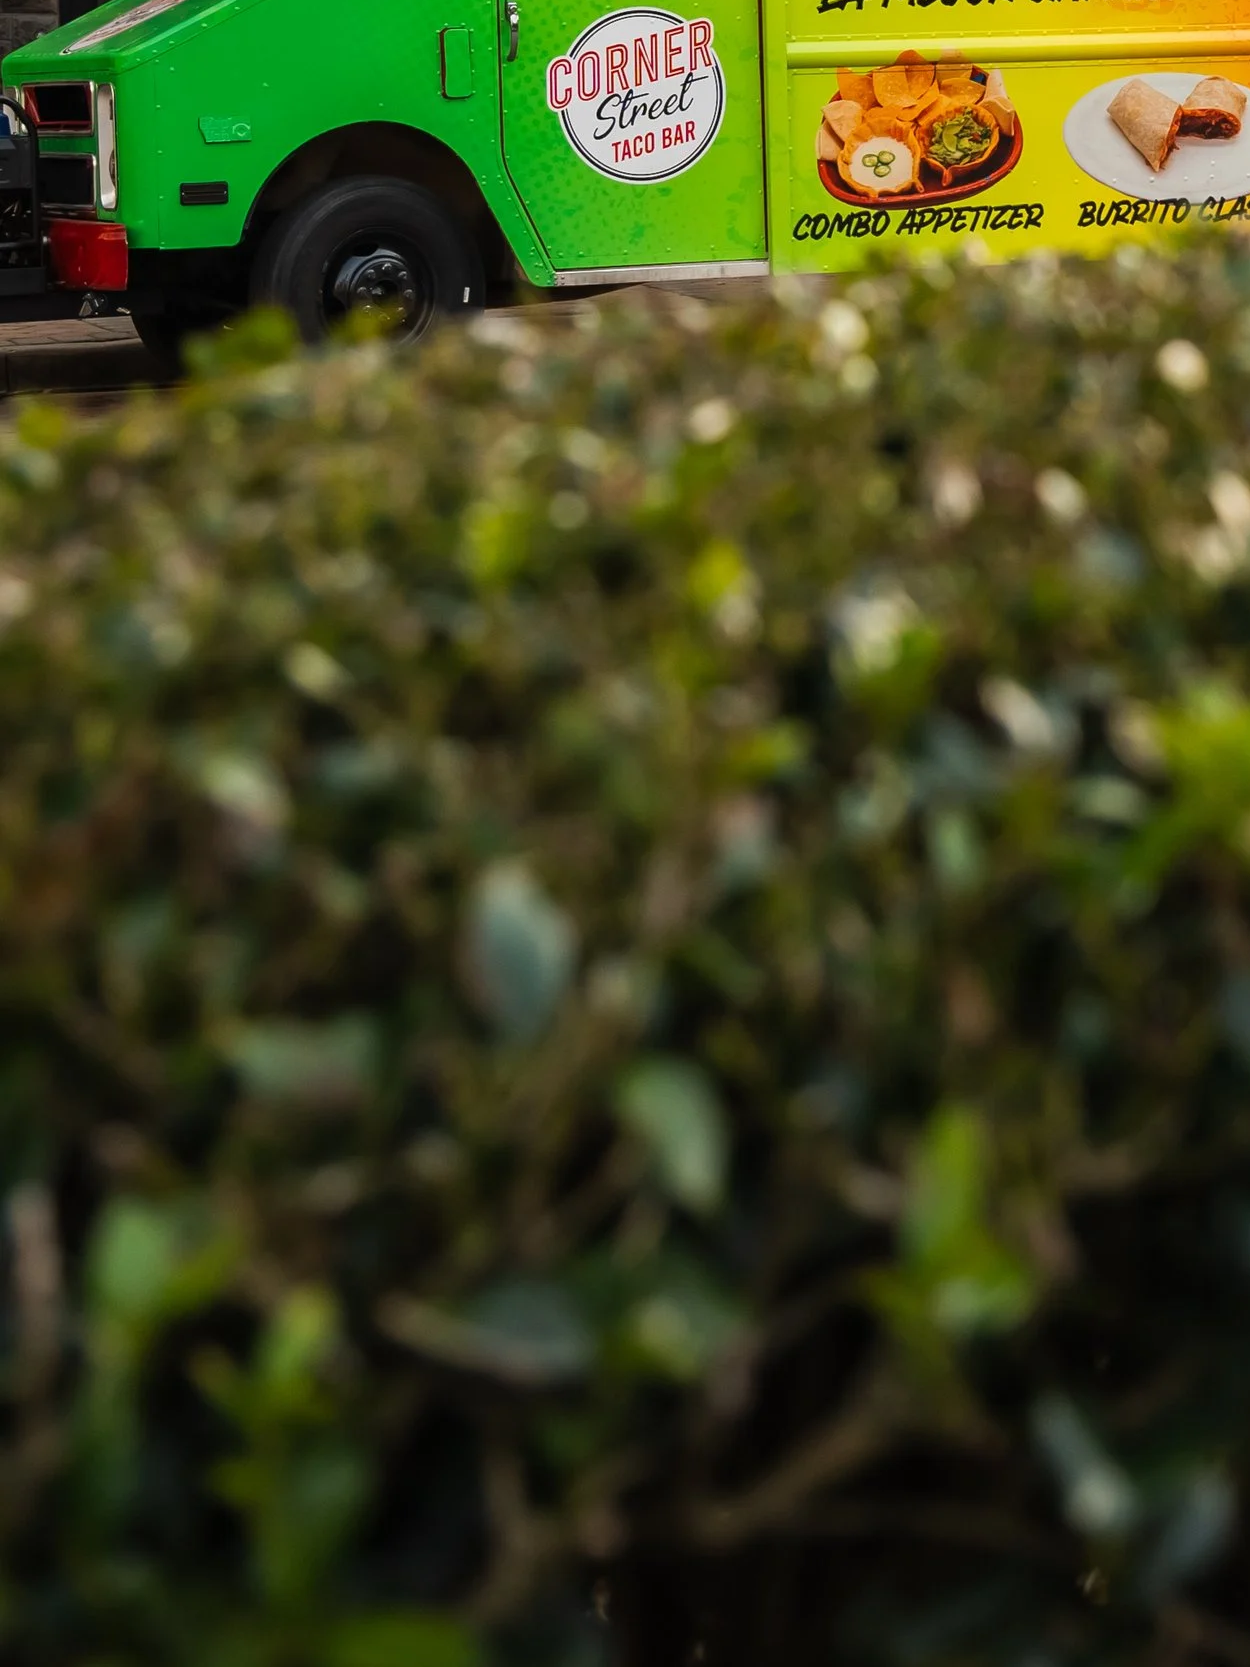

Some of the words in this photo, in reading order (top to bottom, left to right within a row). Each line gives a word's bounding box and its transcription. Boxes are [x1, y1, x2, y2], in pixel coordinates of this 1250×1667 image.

[549, 20, 713, 110] CORNER
[593, 71, 709, 141] Street
[611, 131, 656, 163] TACO
[661, 120, 697, 150] BAR
[792, 210, 891, 242] COMBO
[896, 203, 1045, 236] APPETIZER
[1077, 197, 1191, 228] BURRITO
